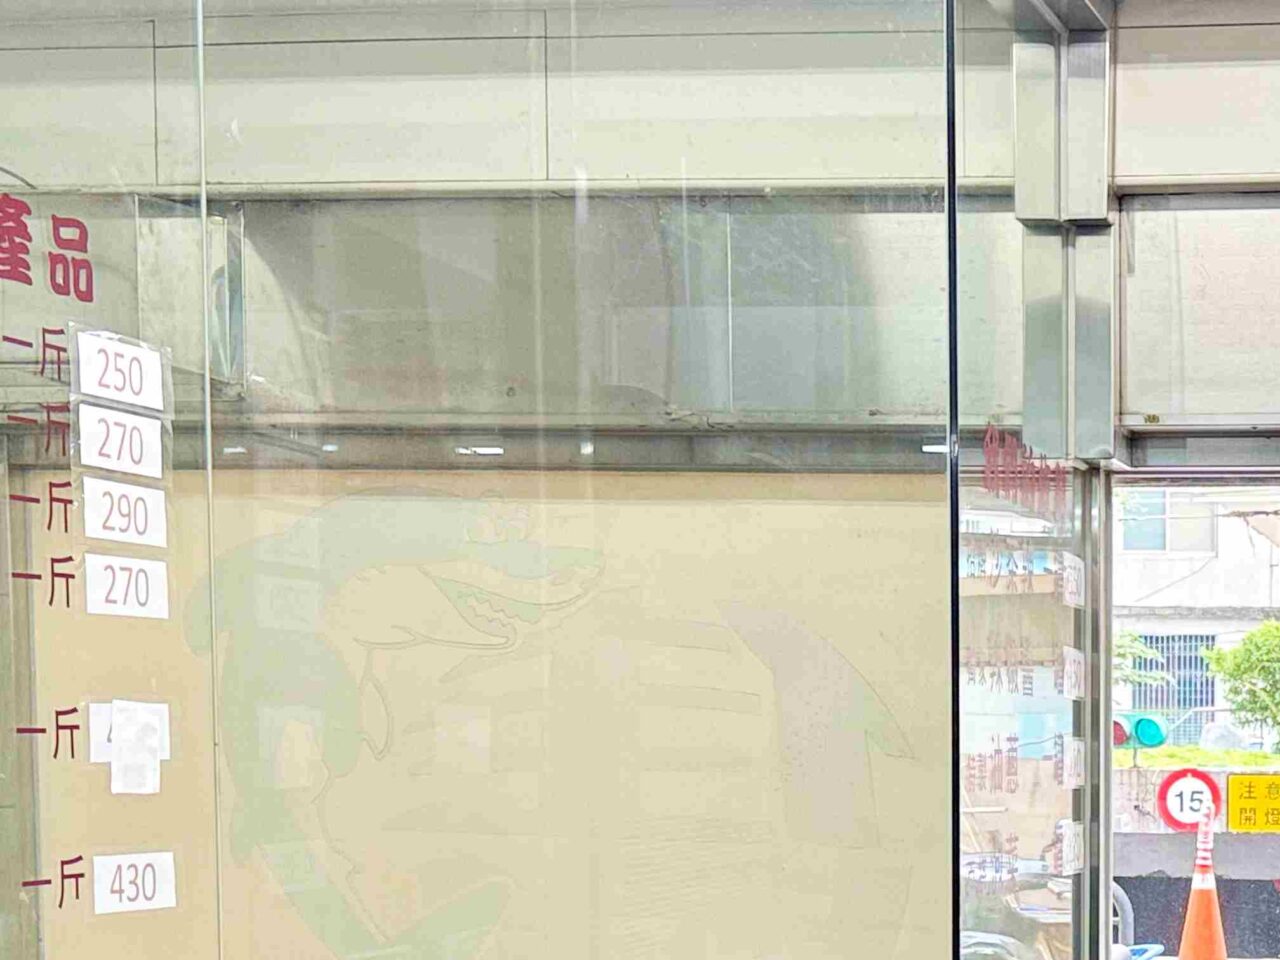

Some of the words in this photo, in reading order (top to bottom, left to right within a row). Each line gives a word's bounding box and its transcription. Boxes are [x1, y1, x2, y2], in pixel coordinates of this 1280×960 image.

[2, 327, 67, 381] 一斤
[97, 348, 144, 396] 250
[7, 403, 71, 457] 一斤
[97, 418, 144, 466] 270
[9, 481, 73, 533] 一斤
[102, 490, 149, 536] 290
[12, 556, 76, 608] 一斤
[104, 564, 150, 607] 270
[16, 707, 80, 759] 一斤
[1175, 790, 1204, 813] 15
[22, 855, 85, 909] 一斤
[110, 862, 157, 903] 430
